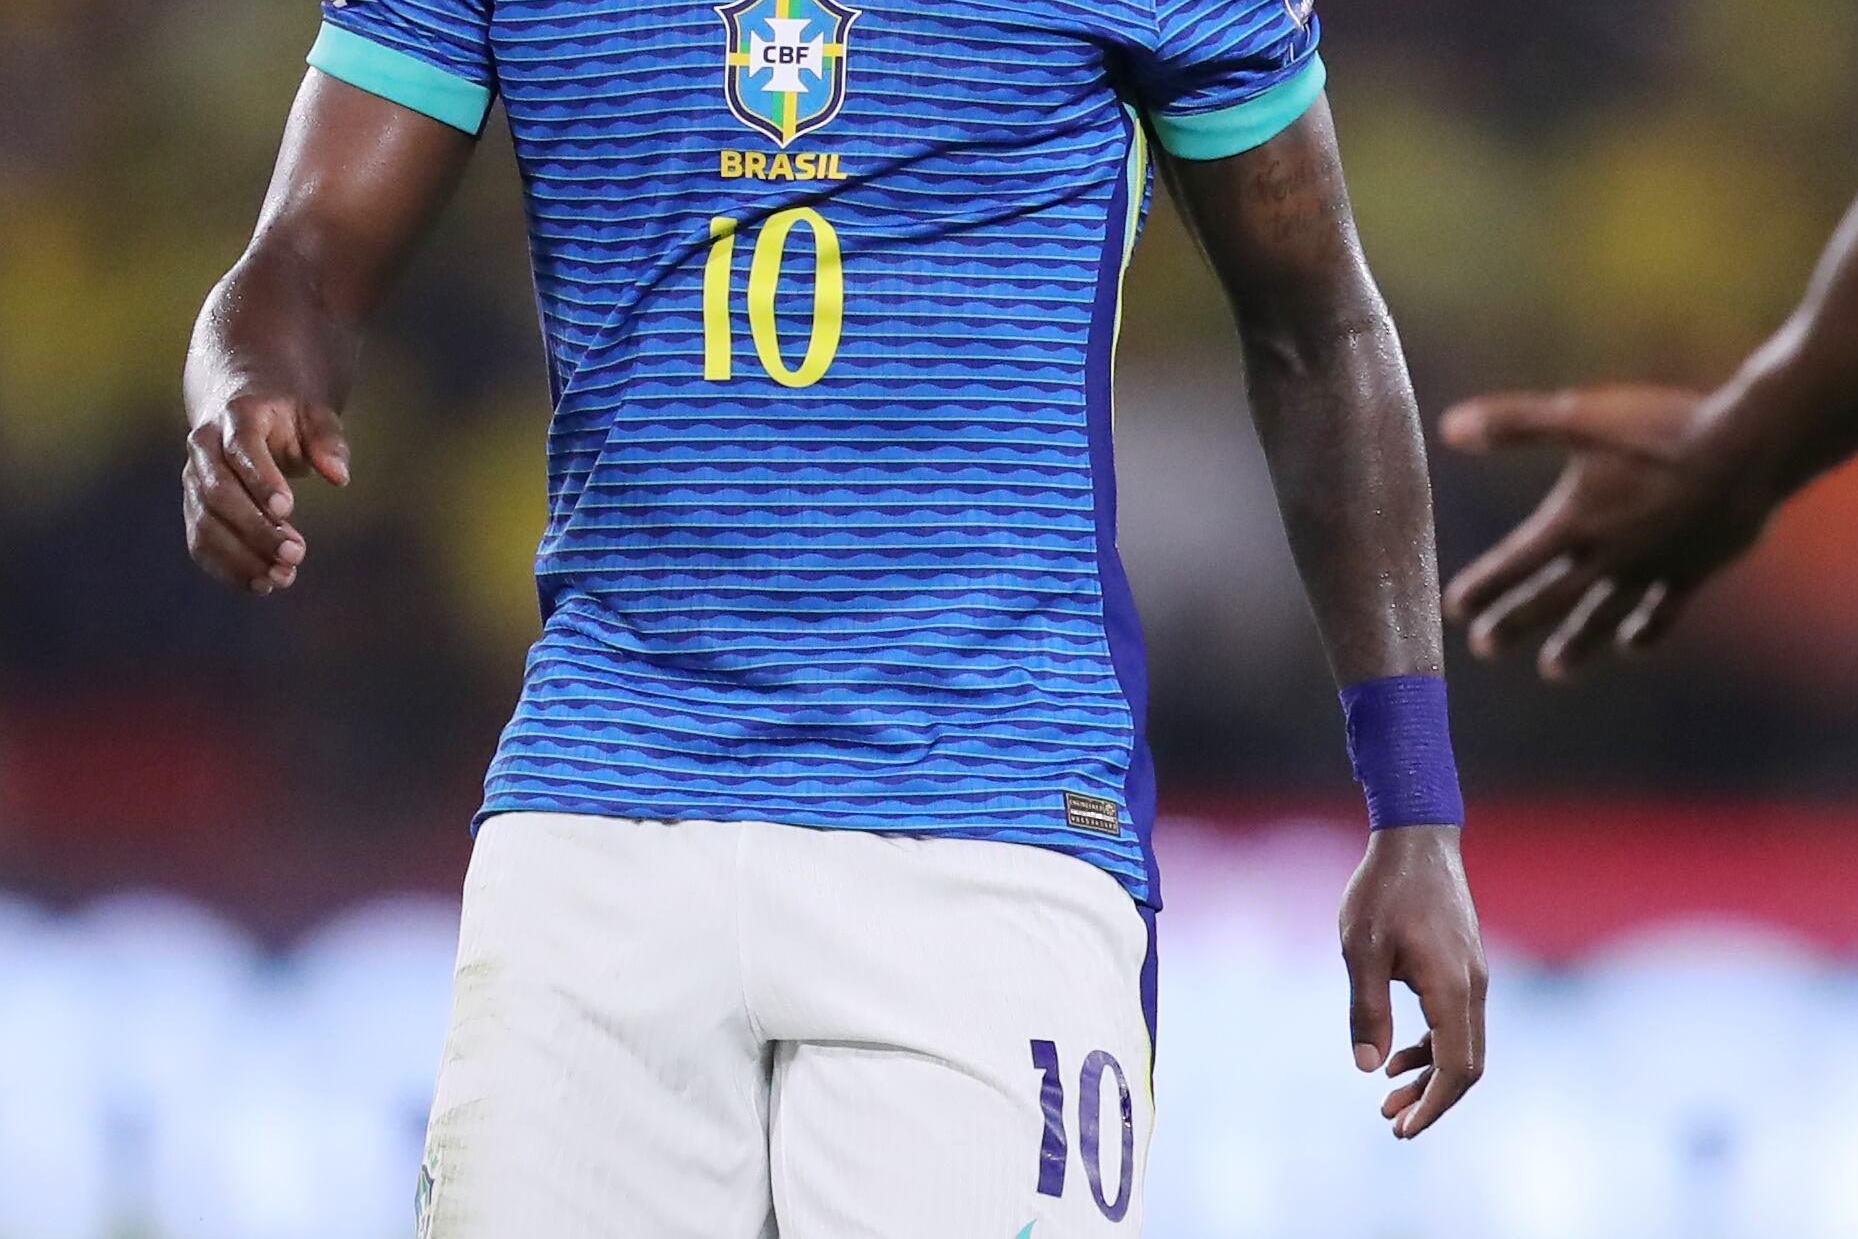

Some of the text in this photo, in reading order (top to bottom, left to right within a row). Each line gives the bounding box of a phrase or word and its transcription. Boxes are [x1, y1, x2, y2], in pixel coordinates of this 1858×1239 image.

[763, 46, 810, 65] CBF
[720, 150, 849, 181] BRASIL
[704, 207, 844, 388] 10
[1030, 1039, 1133, 1223] 10
